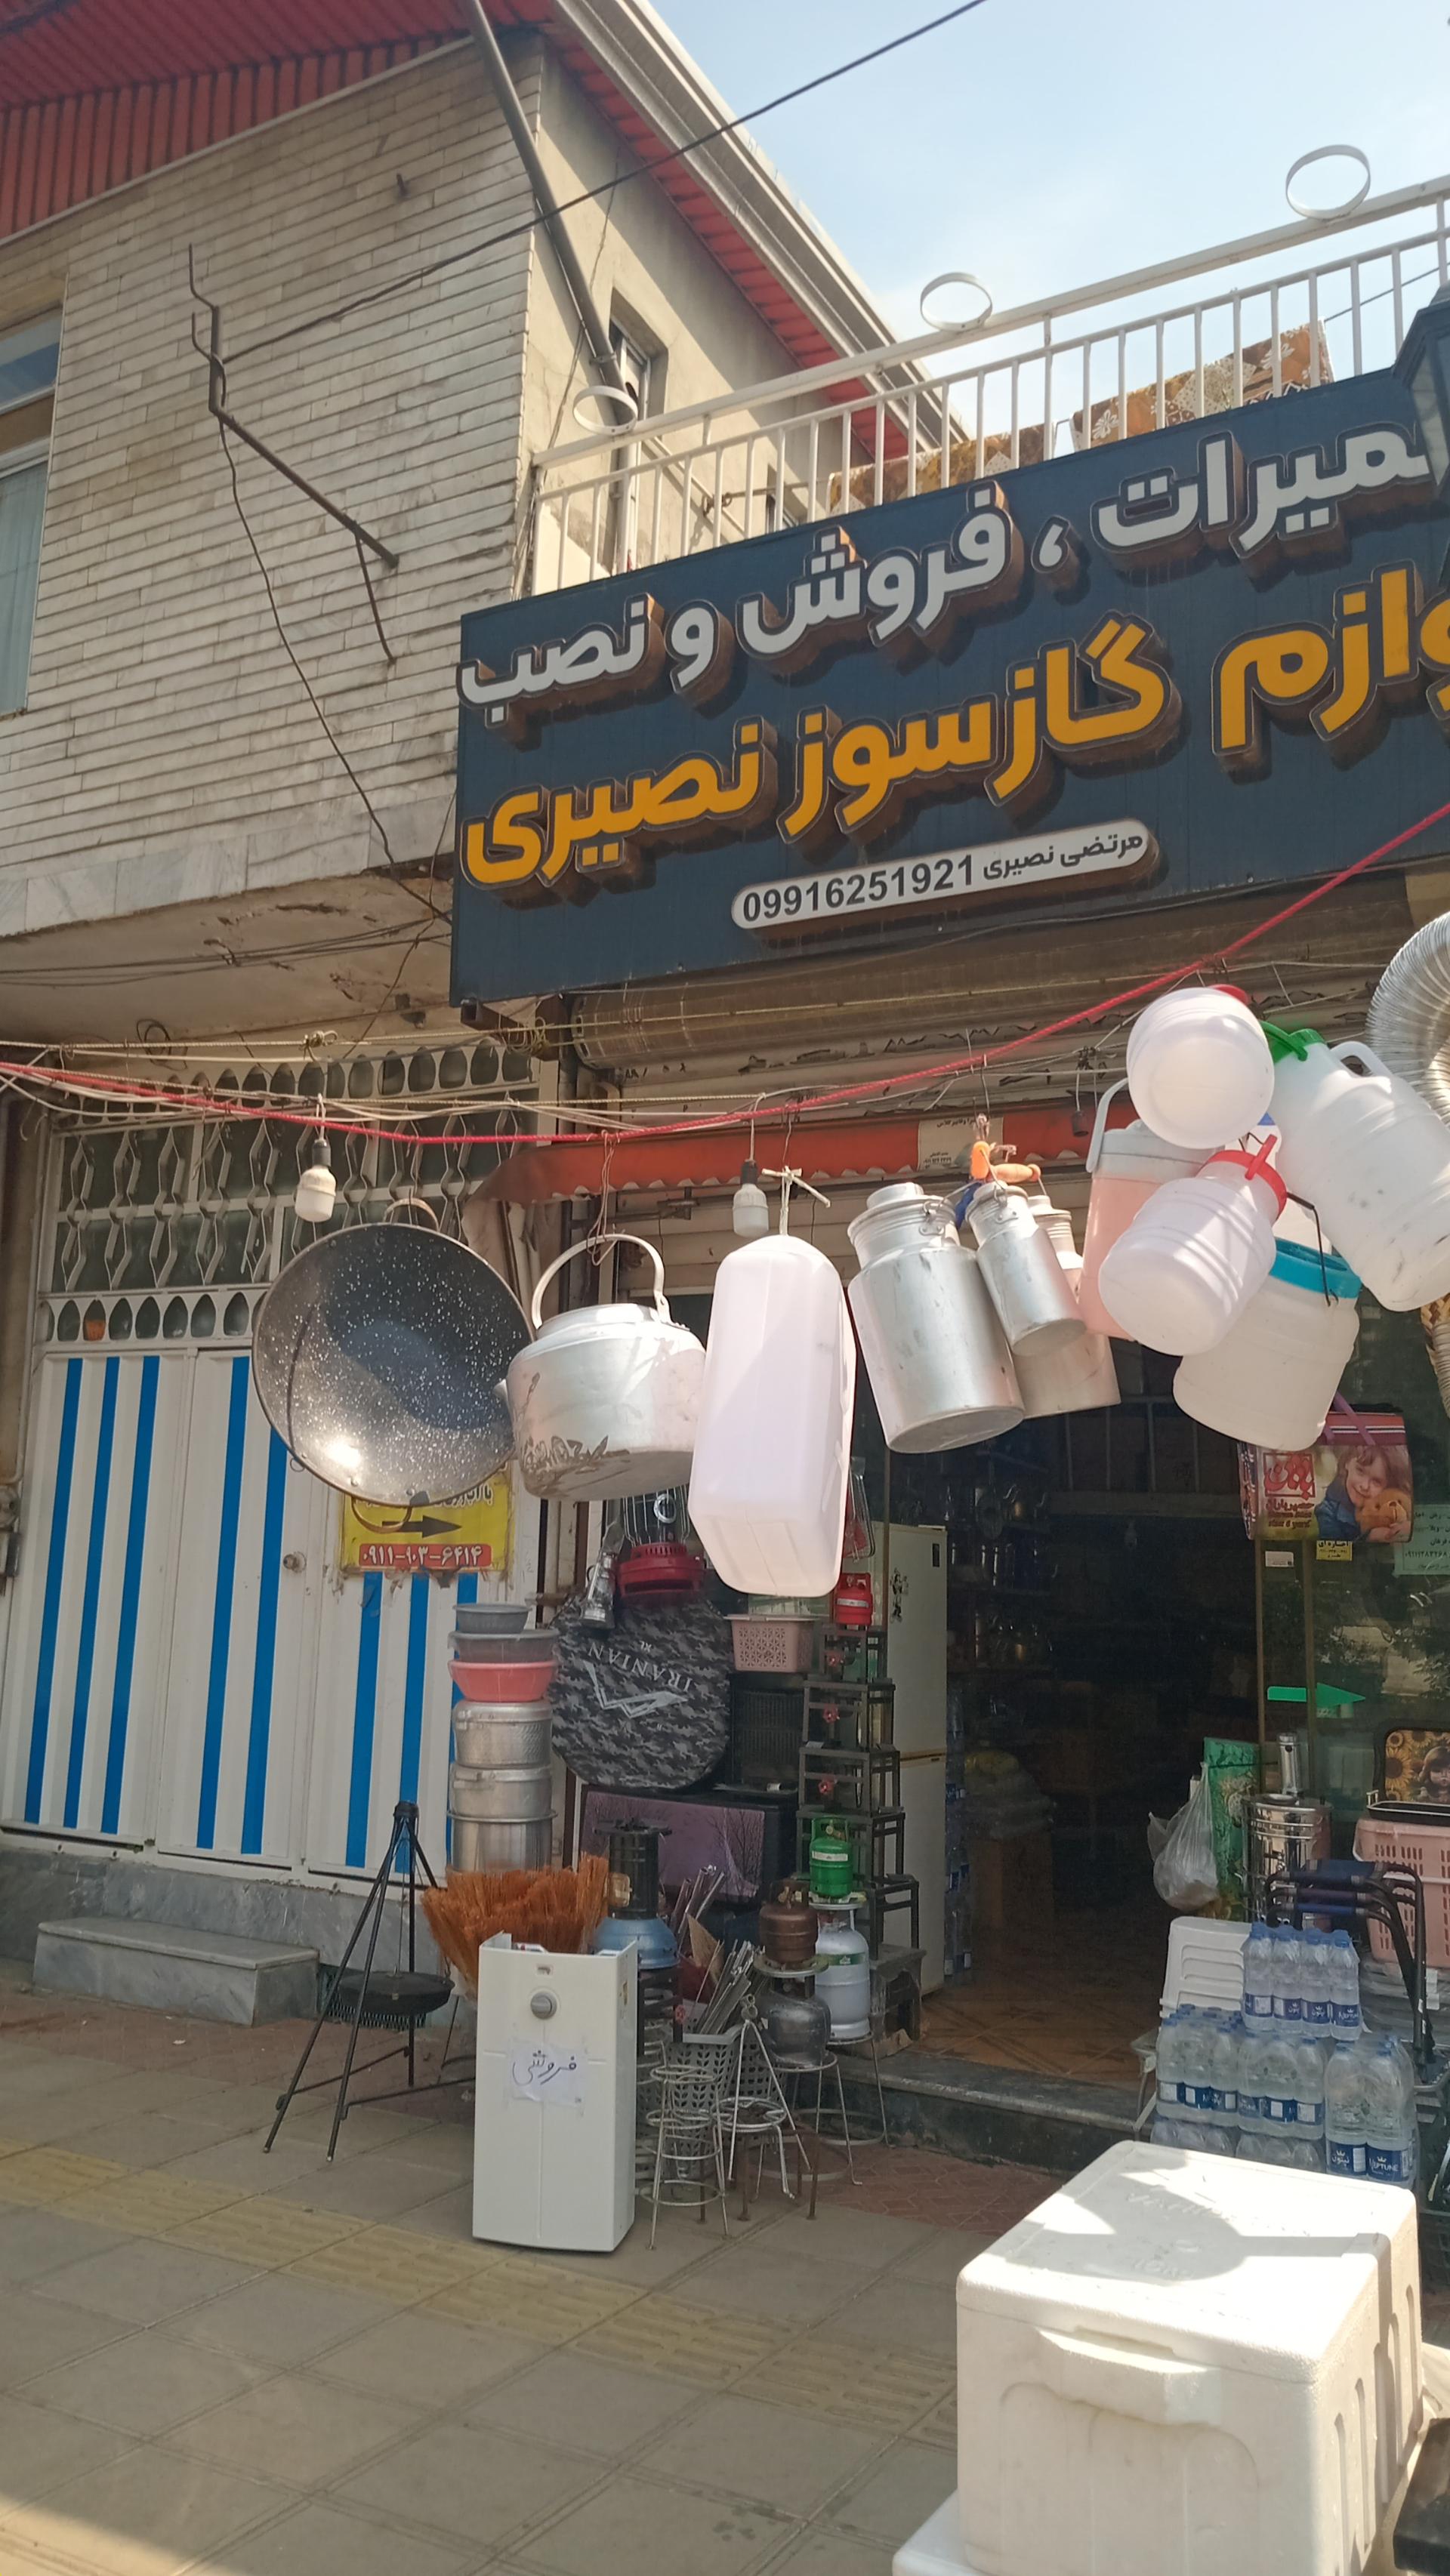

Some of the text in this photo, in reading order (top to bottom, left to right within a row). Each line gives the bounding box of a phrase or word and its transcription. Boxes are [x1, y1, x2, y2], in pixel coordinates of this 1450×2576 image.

[1098, 426, 1430, 551] میرات
[742, 485, 1007, 655] فروش
[461, 599, 649, 724] نصب
[671, 607, 716, 688] و
[467, 723, 758, 883] نصیری
[743, 834, 1143, 923] مرتضی نصیری 09916251921
[588, 1642, 693, 1692] IRANIAN
